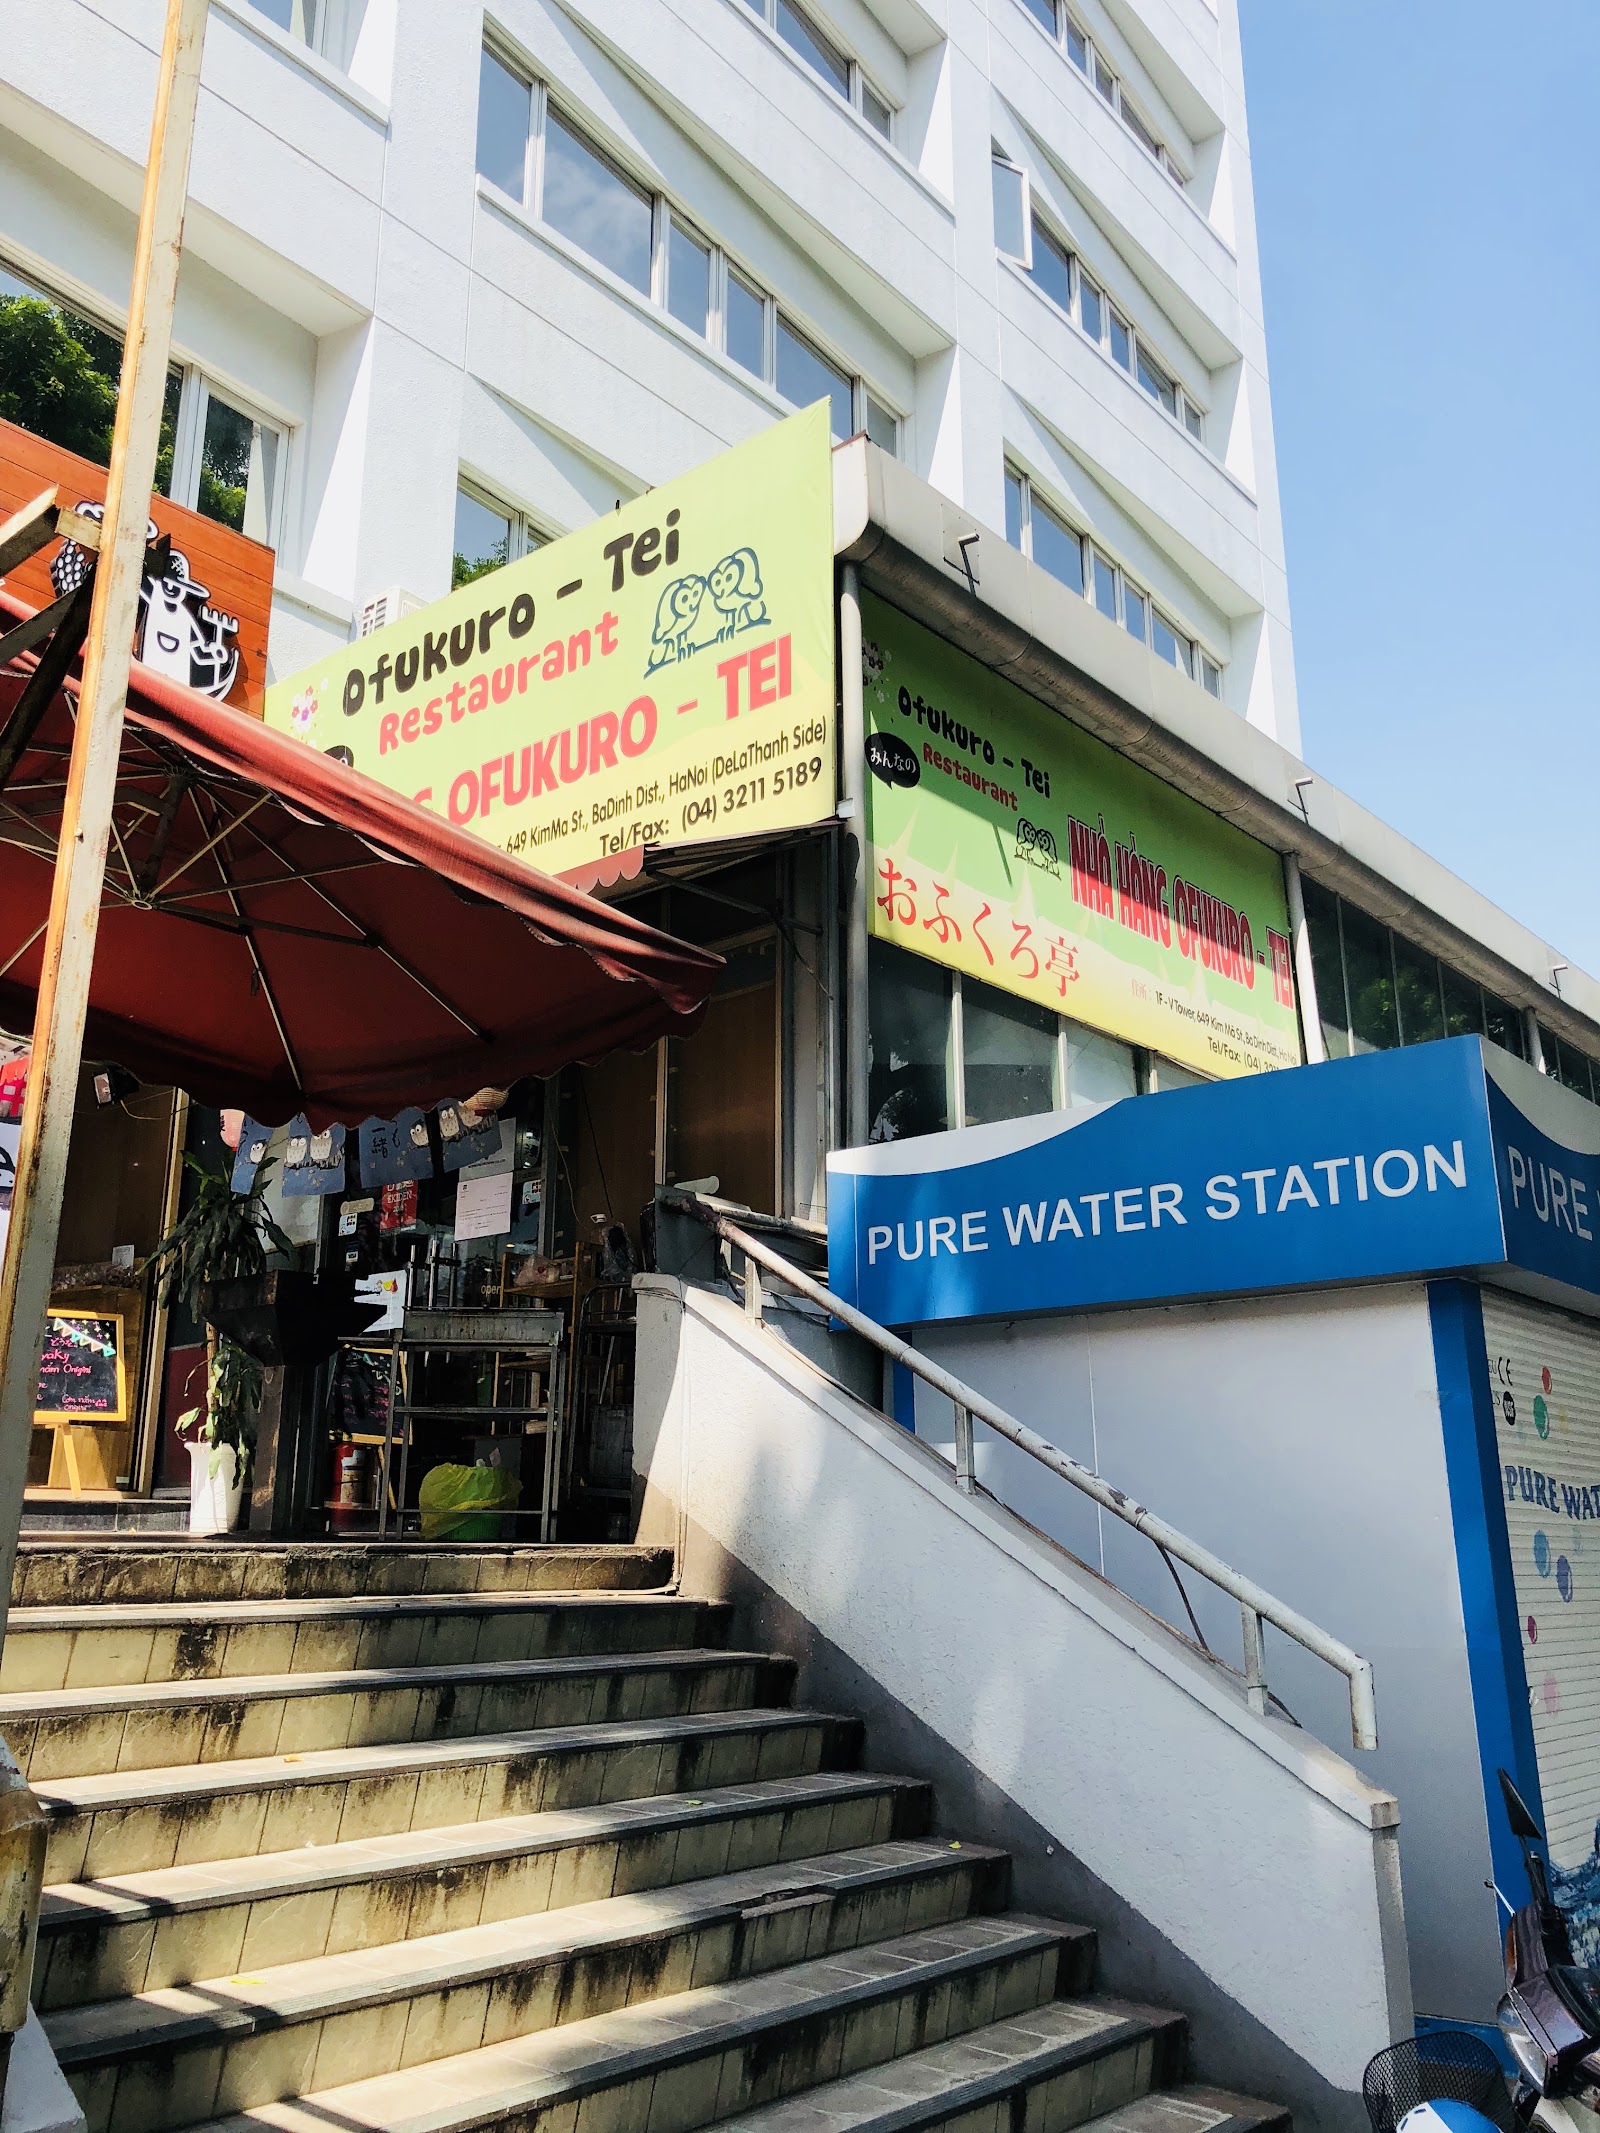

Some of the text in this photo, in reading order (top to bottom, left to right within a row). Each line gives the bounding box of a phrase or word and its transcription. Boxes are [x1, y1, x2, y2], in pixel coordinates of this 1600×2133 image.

[342, 593, 536, 716] Ofukuro
[603, 508, 681, 593] Tei
[379, 611, 619, 755] Restaurant
[449, 695, 658, 826] OFUKURO
[717, 633, 793, 721] TEI
[530, 818, 568, 848] KimMa
[592, 796, 632, 825] BaDinh
[669, 762, 709, 797] HaNoi
[712, 730, 789, 786] (DeLaThanh
[793, 715, 827, 750] Side)
[870, 747, 916, 774] みんなの
[898, 685, 995, 766] Ofukuro
[1021, 757, 1051, 799] Tei
[923, 742, 1018, 812] Restaurant
[600, 756, 822, 857] Tel/Fax: (04) 3211 5189
[877, 858, 1080, 997] おふくろ亭
[1173, 874, 1256, 991] OFUKURO
[1266, 926, 1294, 1010] TEI
[1196, 1010, 1210, 1027] 649
[1210, 1016, 1225, 1034] Kim
[1207, 1036, 1242, 1064] Tel/Fax:
[1244, 1052, 1262, 1074] (04)
[867, 1139, 1468, 1266] PURE WATER STATION
[1507, 1145, 1593, 1242] PURE
[1505, 1465, 1560, 1514] PURE
